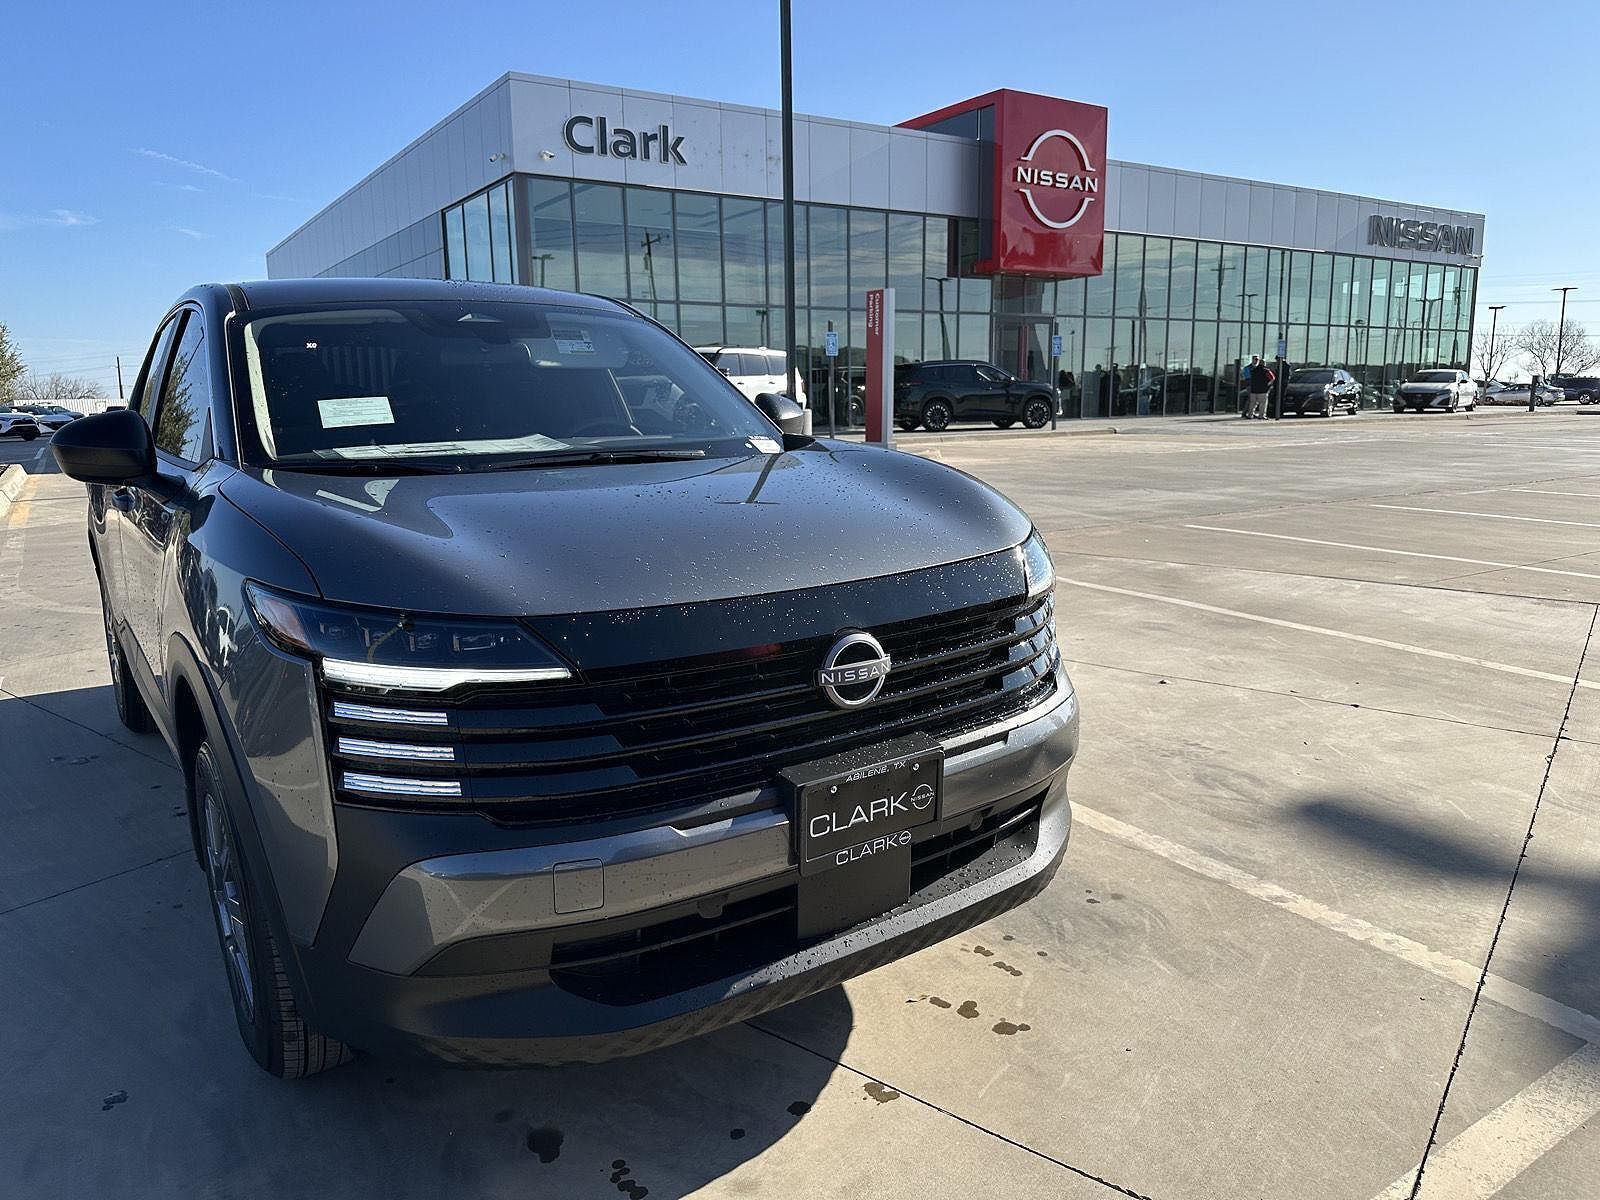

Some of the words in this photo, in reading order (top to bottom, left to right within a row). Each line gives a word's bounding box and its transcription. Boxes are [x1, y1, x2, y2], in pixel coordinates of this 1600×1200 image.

[563, 115, 688, 166] Clark
[1016, 166, 1098, 193] NISSAN
[1368, 215, 1475, 255] NISSAN
[821, 660, 890, 684] NISSAN
[893, 760, 906, 770] TX
[809, 791, 909, 838] CLARK
[835, 834, 898, 865] CLARK
